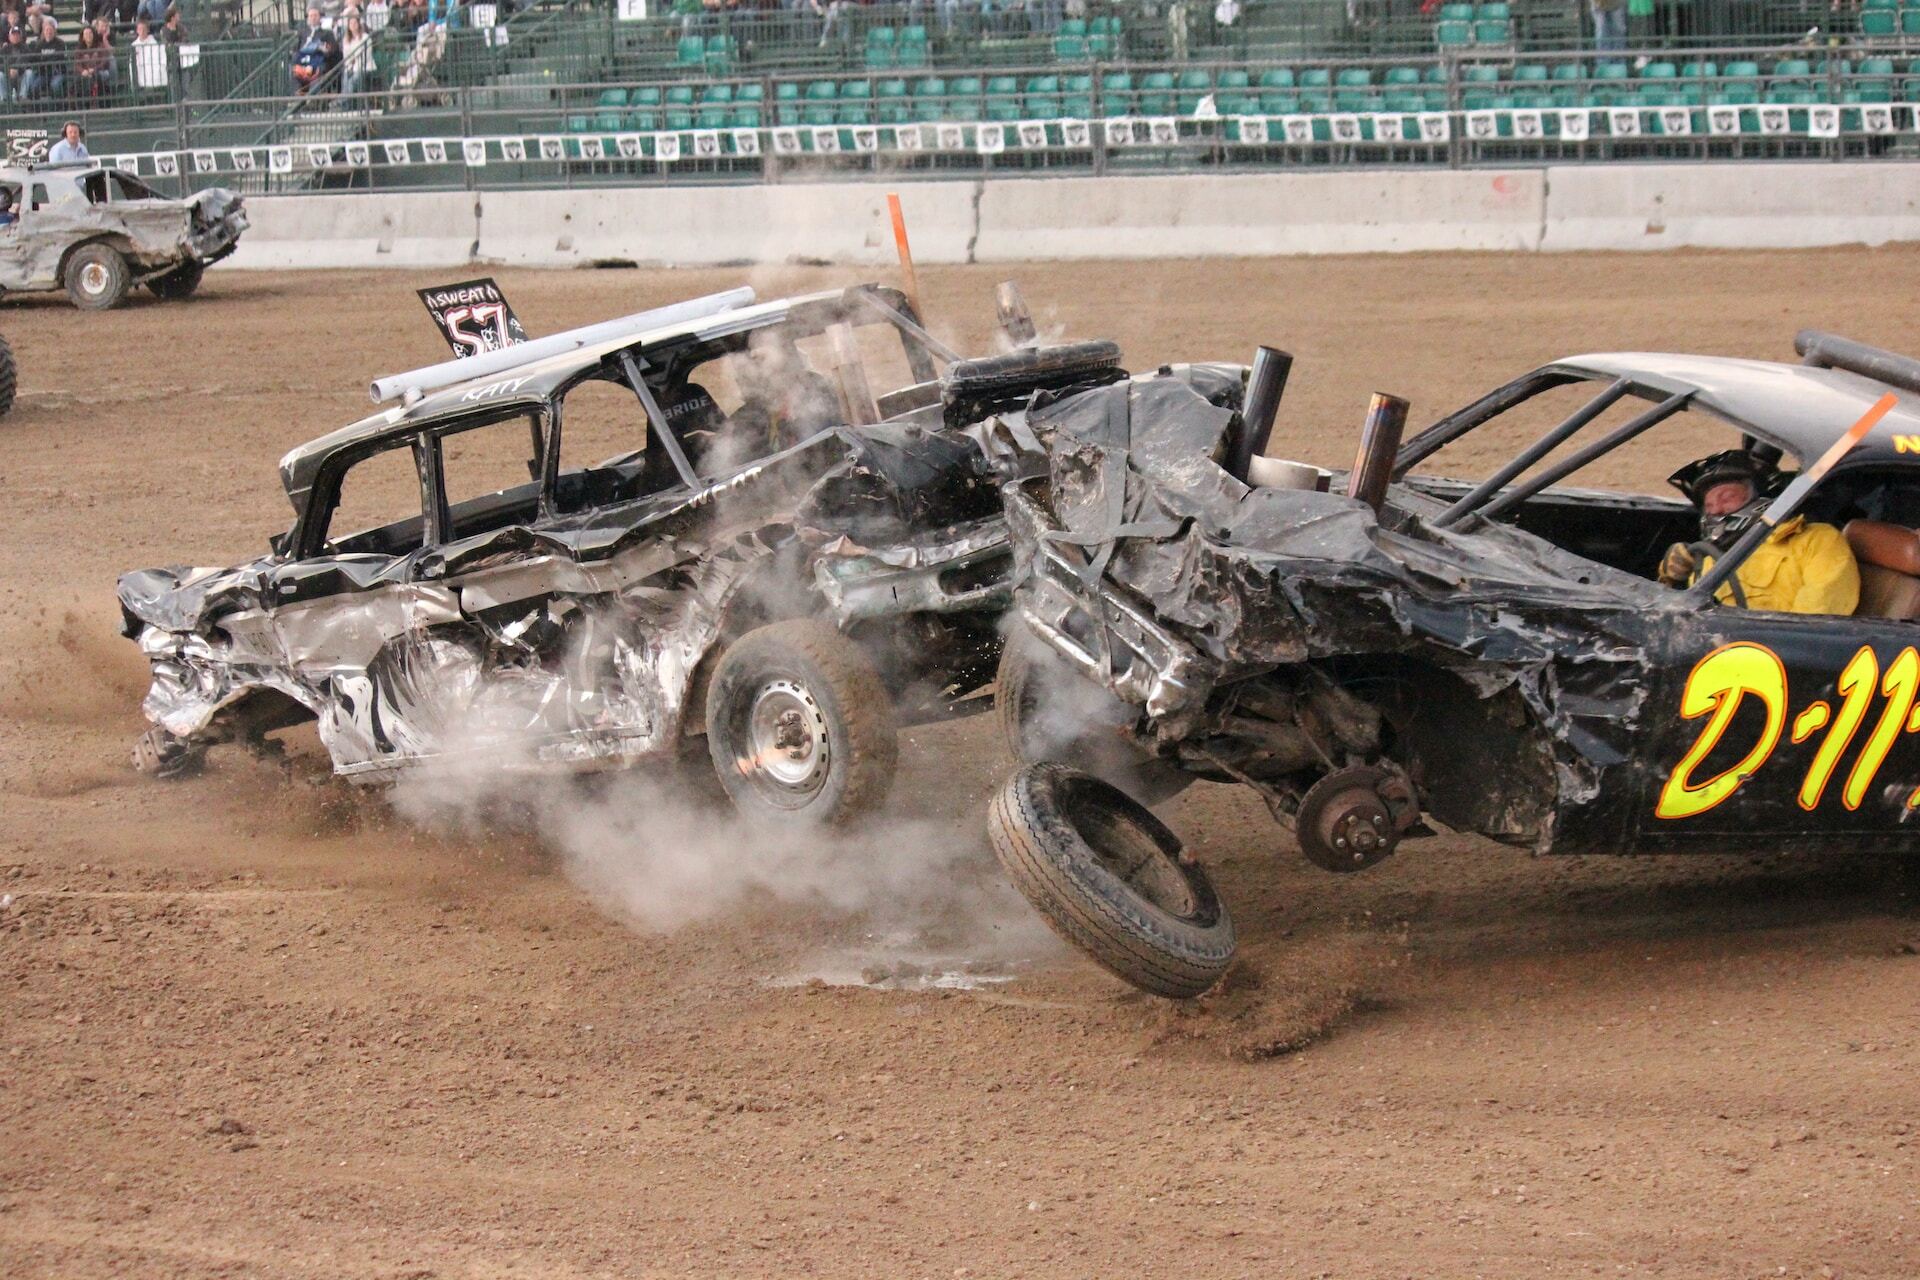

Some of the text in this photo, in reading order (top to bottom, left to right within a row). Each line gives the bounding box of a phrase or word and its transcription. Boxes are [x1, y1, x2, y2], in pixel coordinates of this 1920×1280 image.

[7, 129, 48, 138] MONSTER
[12, 138, 48, 158] 56
[435, 286, 486, 307] SWEAT
[444, 301, 508, 356] 57
[461, 375, 536, 402] KATY
[663, 395, 711, 420] BRIDE
